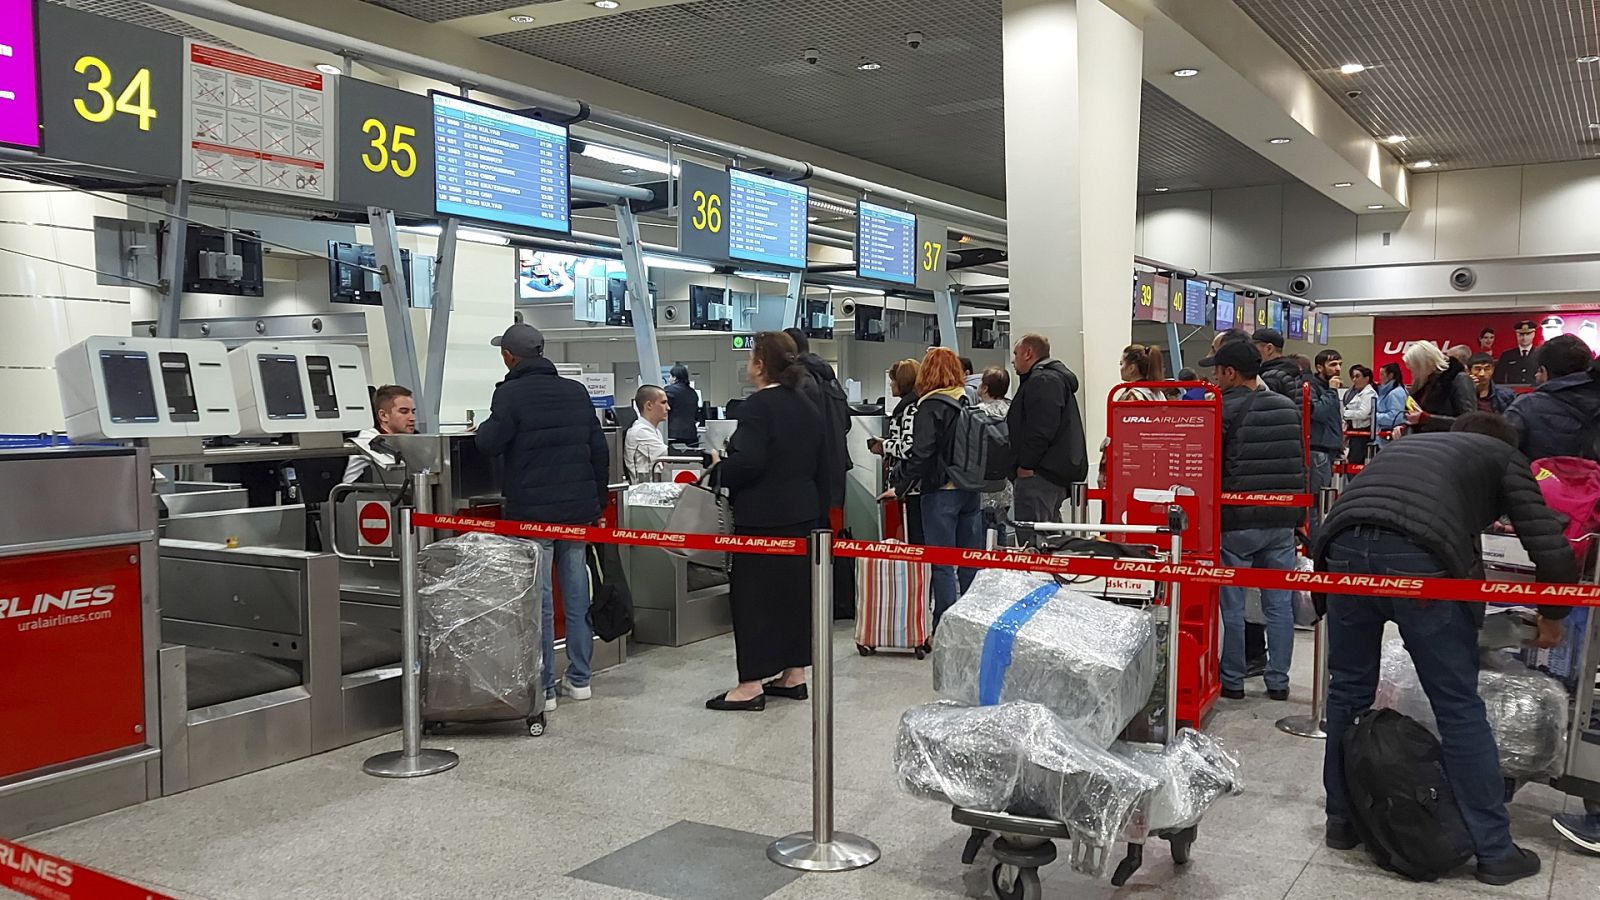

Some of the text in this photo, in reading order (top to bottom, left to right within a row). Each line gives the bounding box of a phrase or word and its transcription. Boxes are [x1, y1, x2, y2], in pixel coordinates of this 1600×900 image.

[73, 56, 157, 131] 34
[361, 118, 418, 178] 35
[692, 190, 722, 233] 36
[923, 240, 942, 272] 37
[1140, 284, 1152, 307] 39
[1173, 291, 1183, 312] 40
[1245, 494, 1294, 502] AIRLINES
[434, 516, 496, 528] URAL AIRLINES
[519, 523, 586, 535] URAL AIRLINES
[612, 530, 686, 542] URAL AIRLINES
[714, 536, 796, 549] URAL AIRLINES
[864, 543, 925, 556] AIRLINES
[962, 550, 1070, 567] URAL AIRLINES
[1113, 562, 1236, 578] URAL AIRLINES
[1285, 572, 1424, 589] URAL AIRLINES
[1480, 582, 1537, 594] URAL
[17, 609, 112, 631] uralairlines.com
